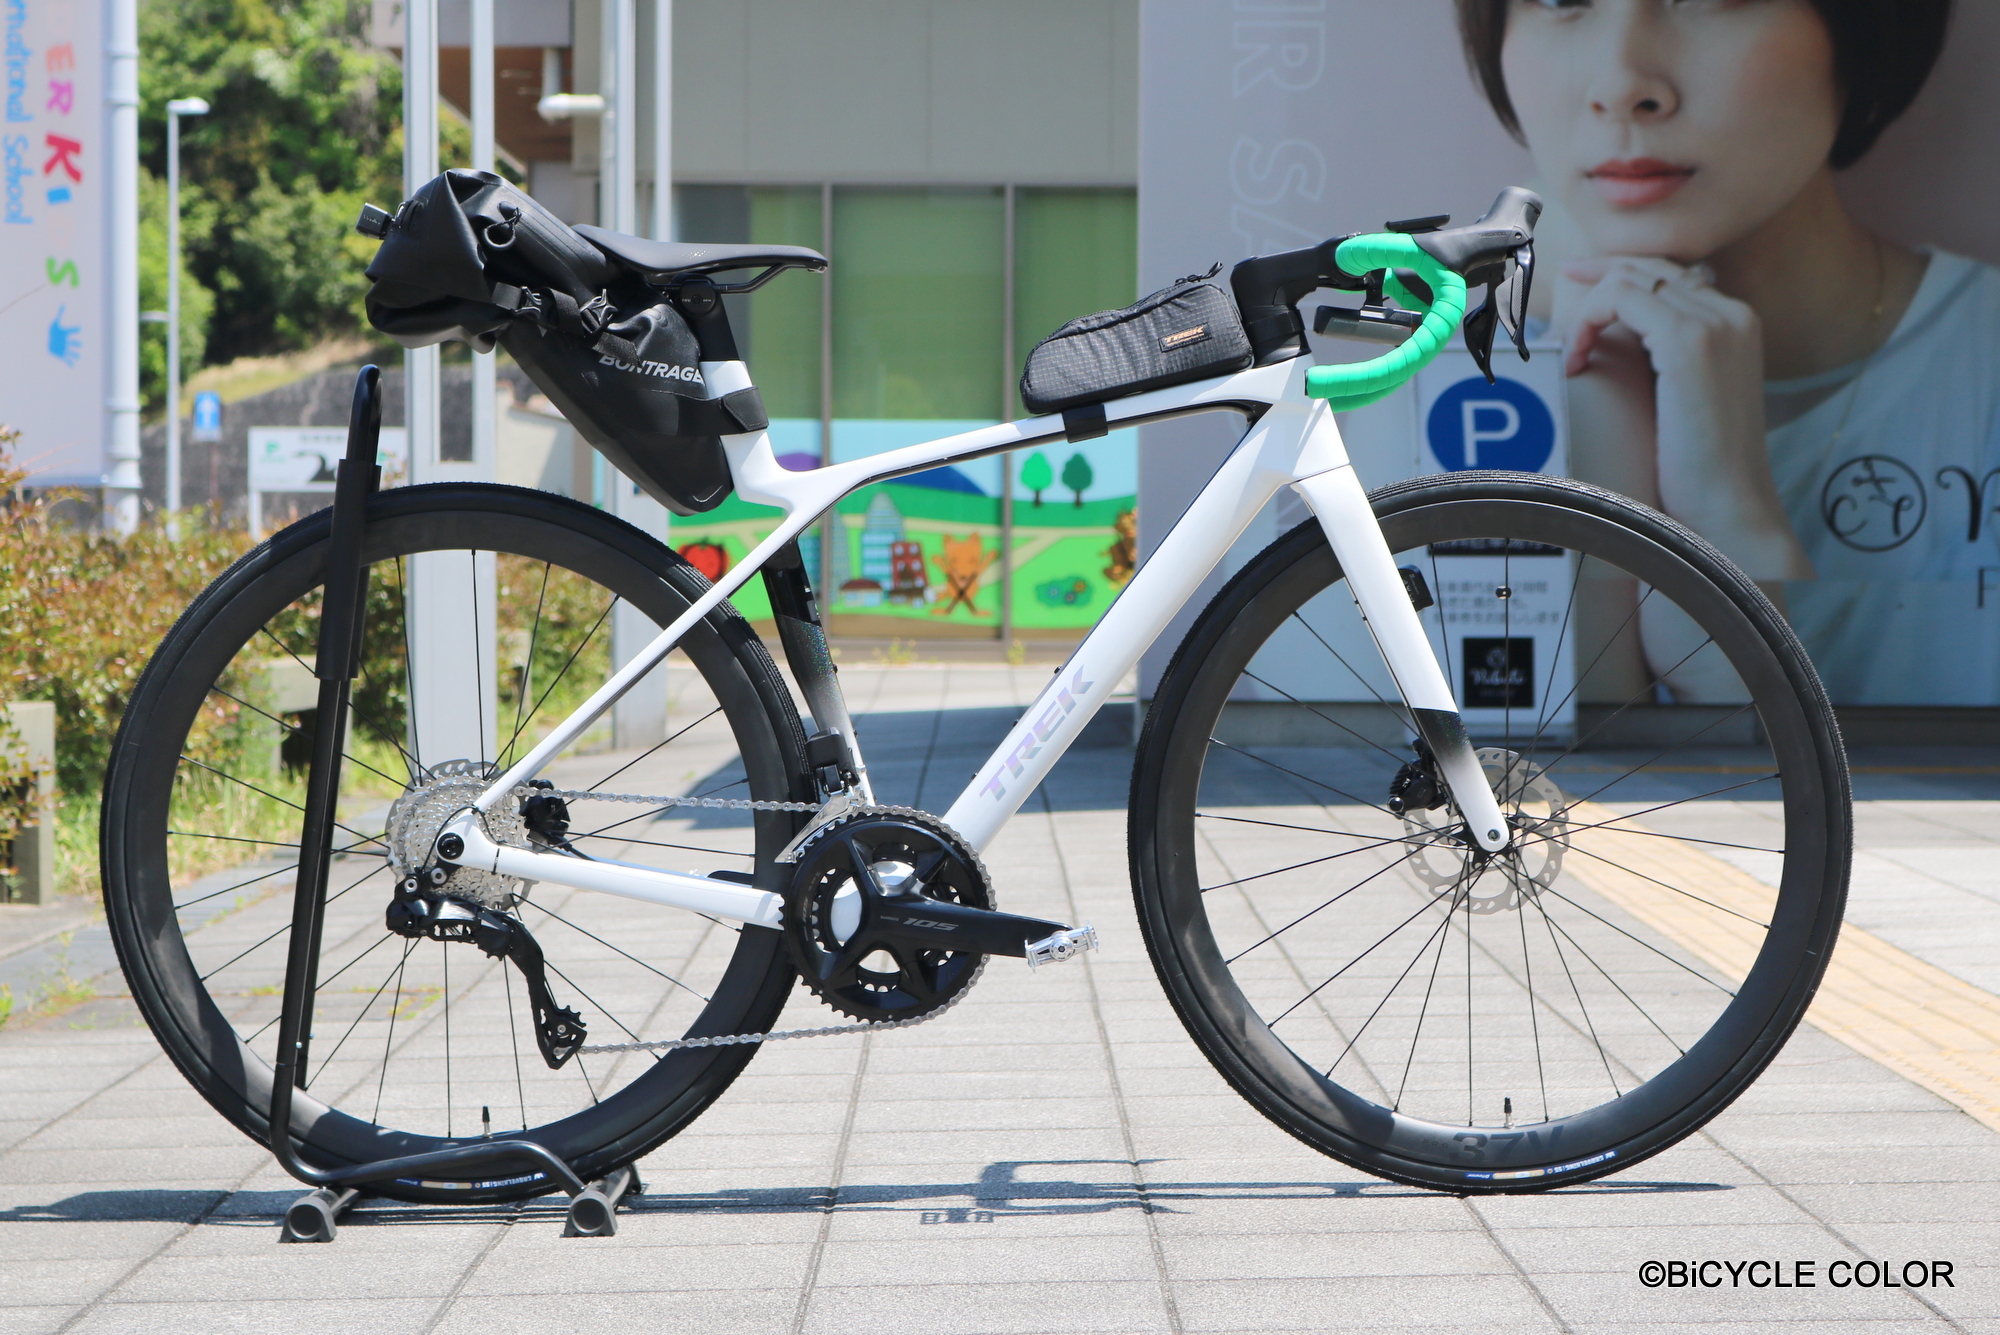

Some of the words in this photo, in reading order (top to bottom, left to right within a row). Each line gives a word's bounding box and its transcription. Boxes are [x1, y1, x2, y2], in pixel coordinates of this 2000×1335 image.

[4, 134, 34, 224] School
[1461, 399, 1521, 468] P
[979, 664, 1096, 803] TREK
[903, 917, 960, 931] 105
[1448, 1125, 1564, 1165] 37V
